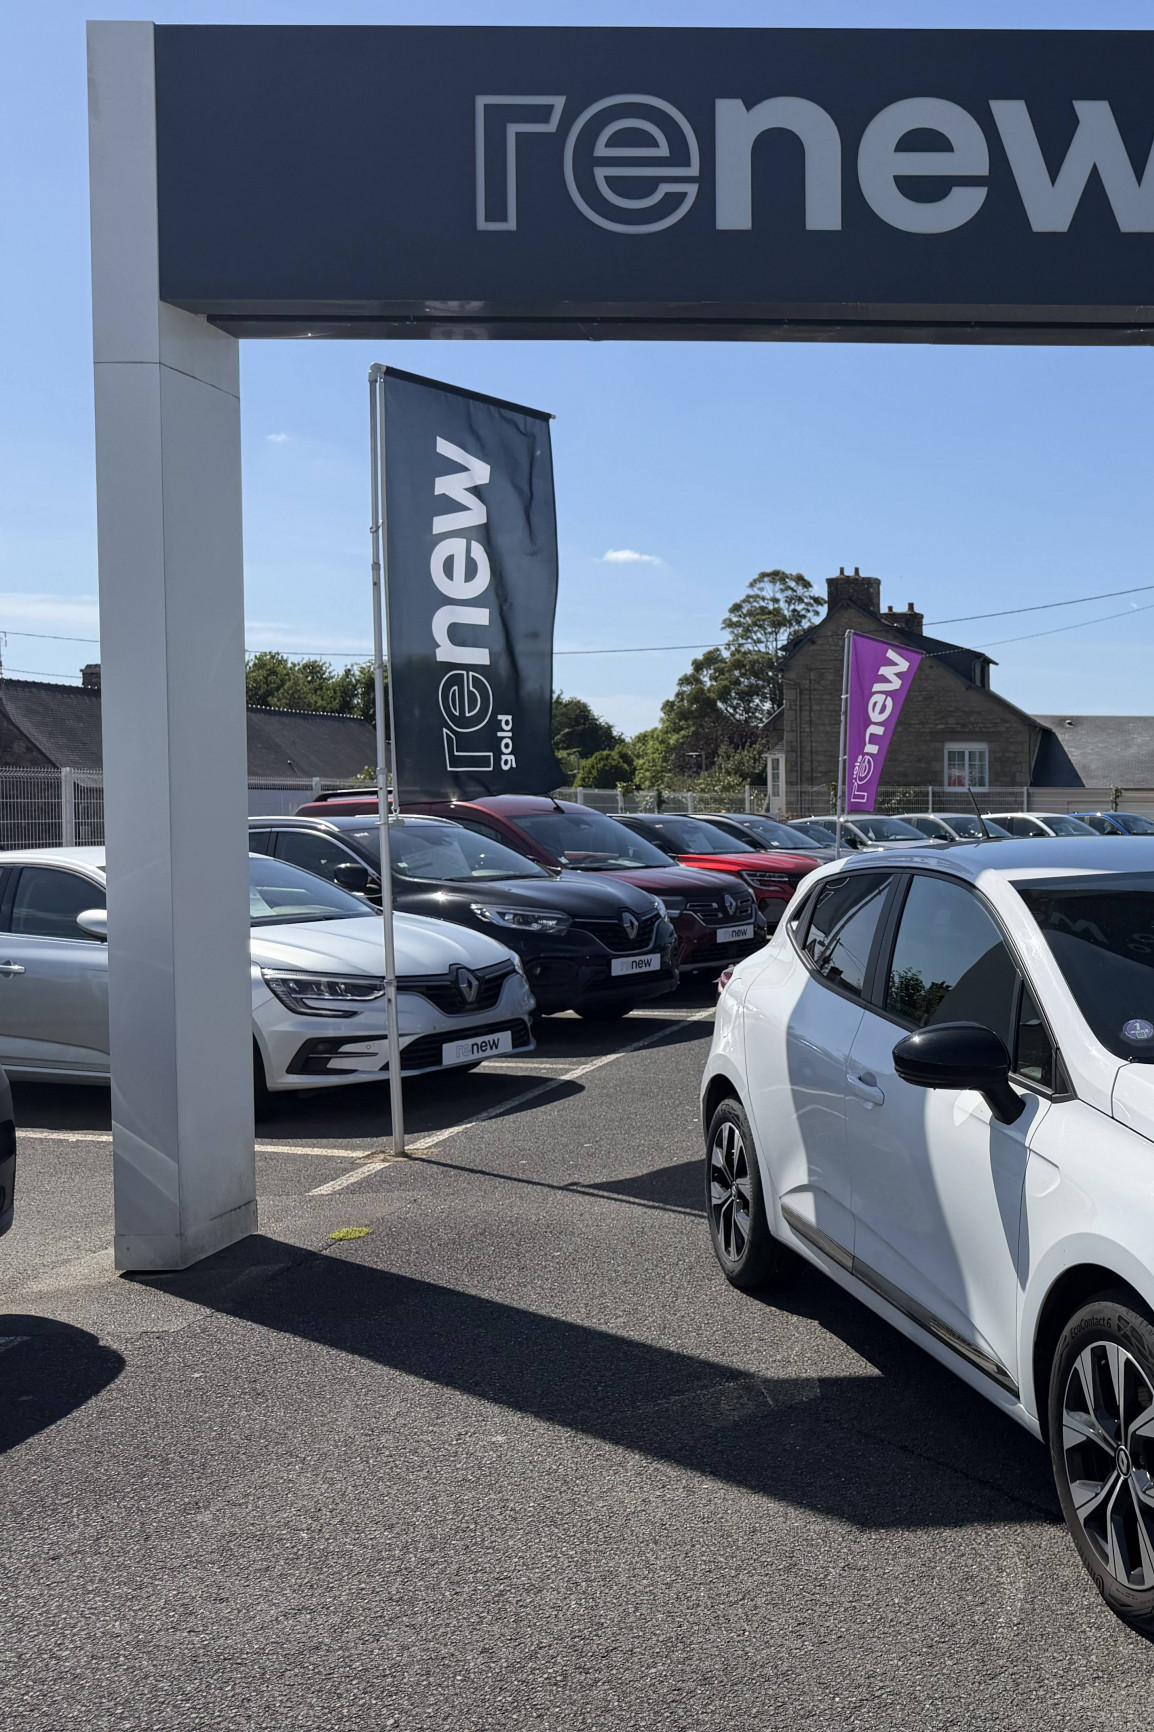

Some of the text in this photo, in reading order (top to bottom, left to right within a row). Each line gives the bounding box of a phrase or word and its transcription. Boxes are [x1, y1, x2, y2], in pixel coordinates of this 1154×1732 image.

[430, 435, 494, 772] renew
[497, 714, 517, 772] gold
[851, 648, 910, 803] renew
[455, 1037, 500, 1059] renew
[1070, 1315, 1112, 1339] EcoContact 6
